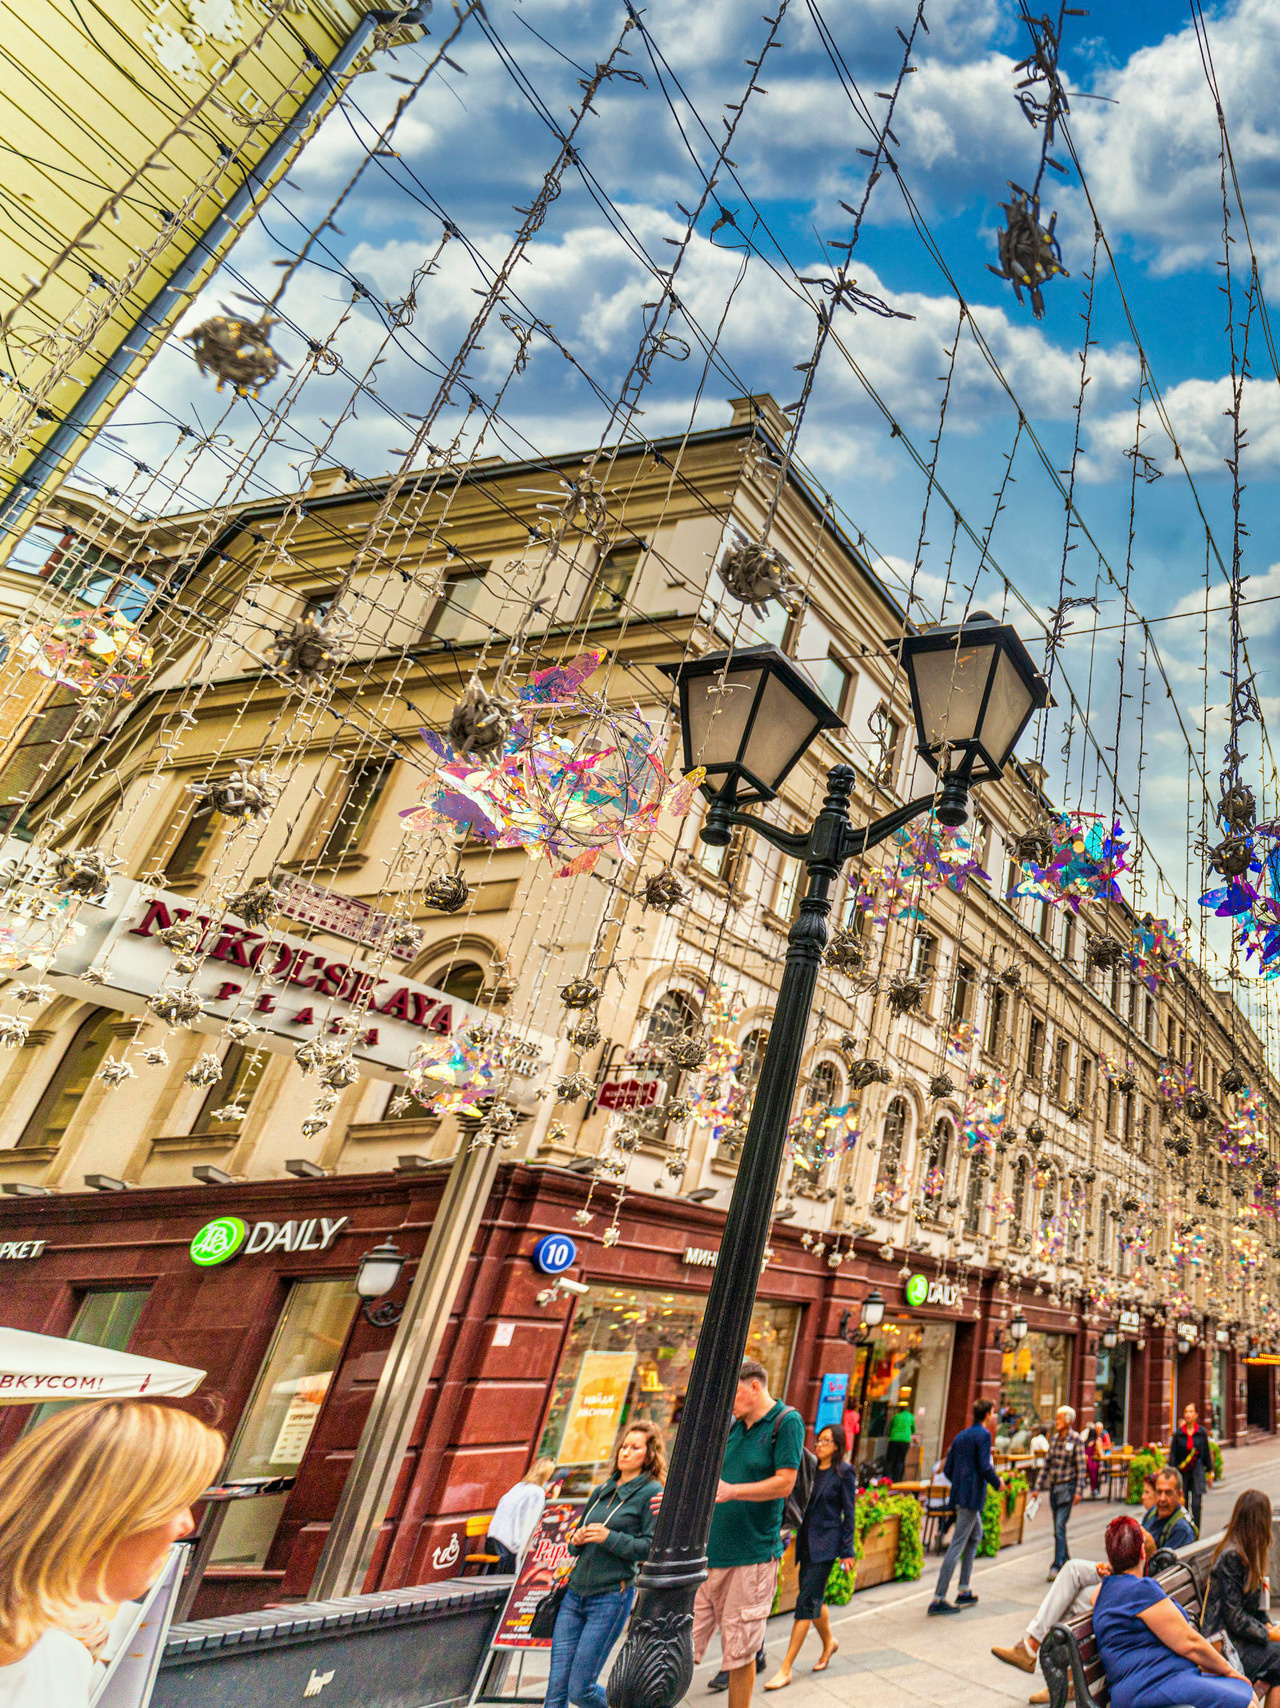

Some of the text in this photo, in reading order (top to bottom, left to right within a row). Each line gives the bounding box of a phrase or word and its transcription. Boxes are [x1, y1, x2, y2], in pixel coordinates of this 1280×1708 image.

[245, 1216, 349, 1255] DAILY
[546, 1243, 569, 1266] 10
[0, 1374, 104, 1390] ВКУСОМ!
